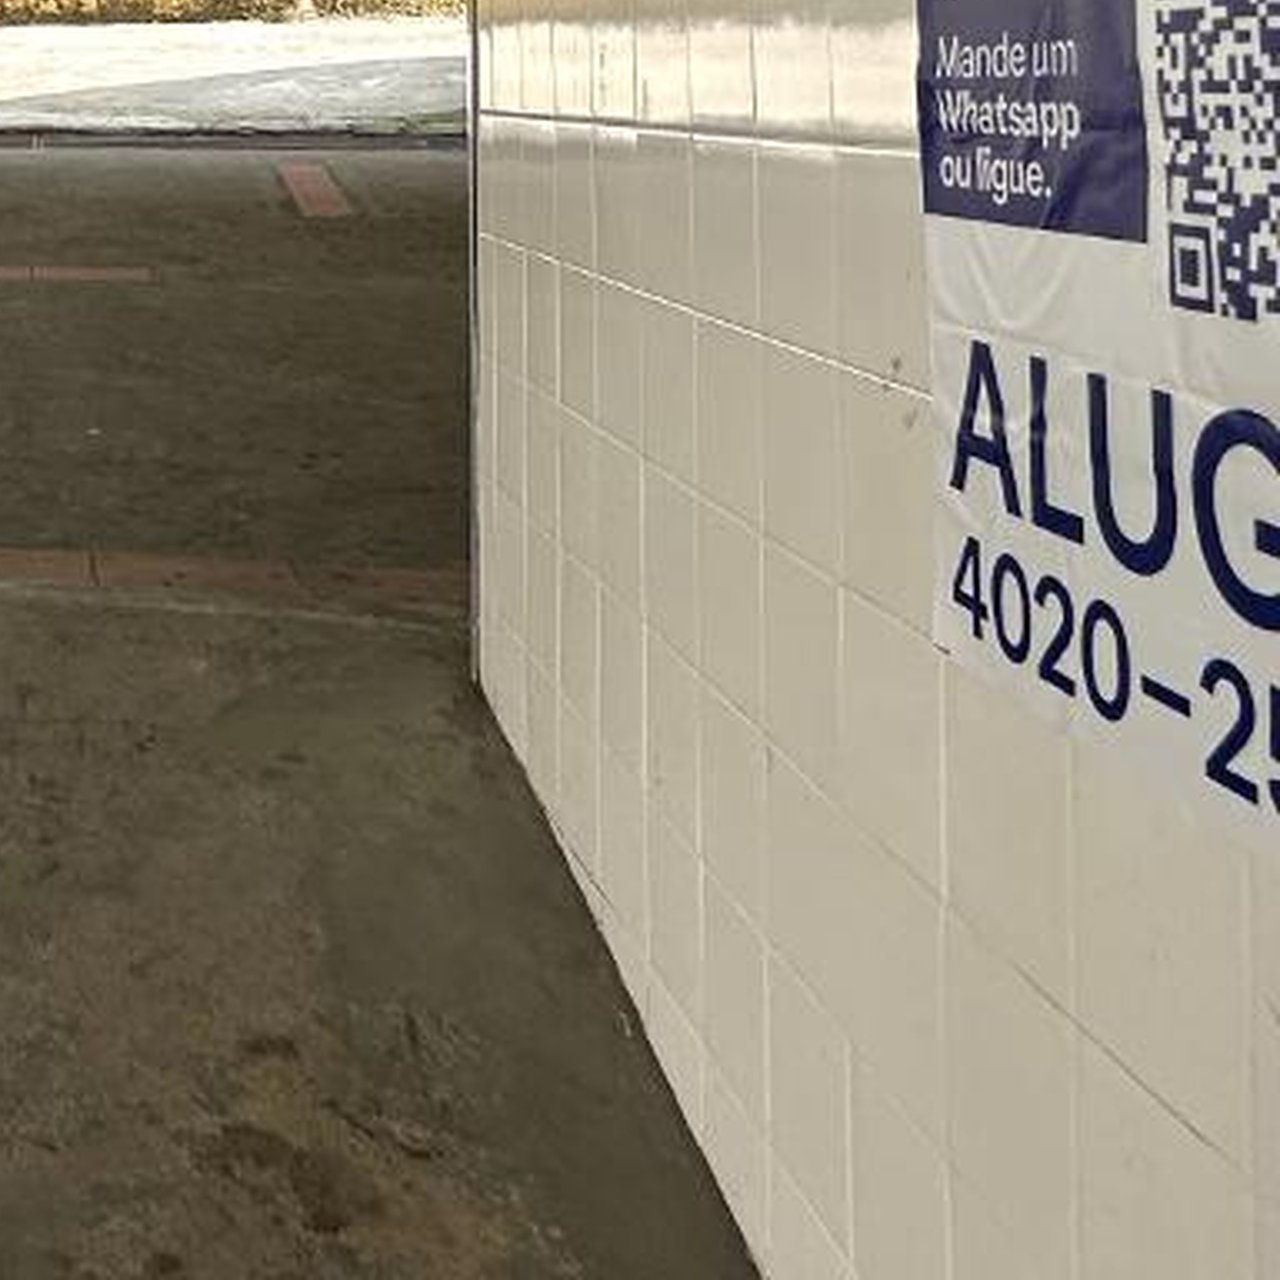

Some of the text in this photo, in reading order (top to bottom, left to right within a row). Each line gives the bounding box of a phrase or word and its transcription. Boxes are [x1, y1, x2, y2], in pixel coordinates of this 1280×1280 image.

[936, 31, 1078, 78] Mande um
[935, 89, 1081, 150] Whatsapp
[940, 145, 1052, 205] ou ligue.
[952, 536, 1280, 813] 4020-2
